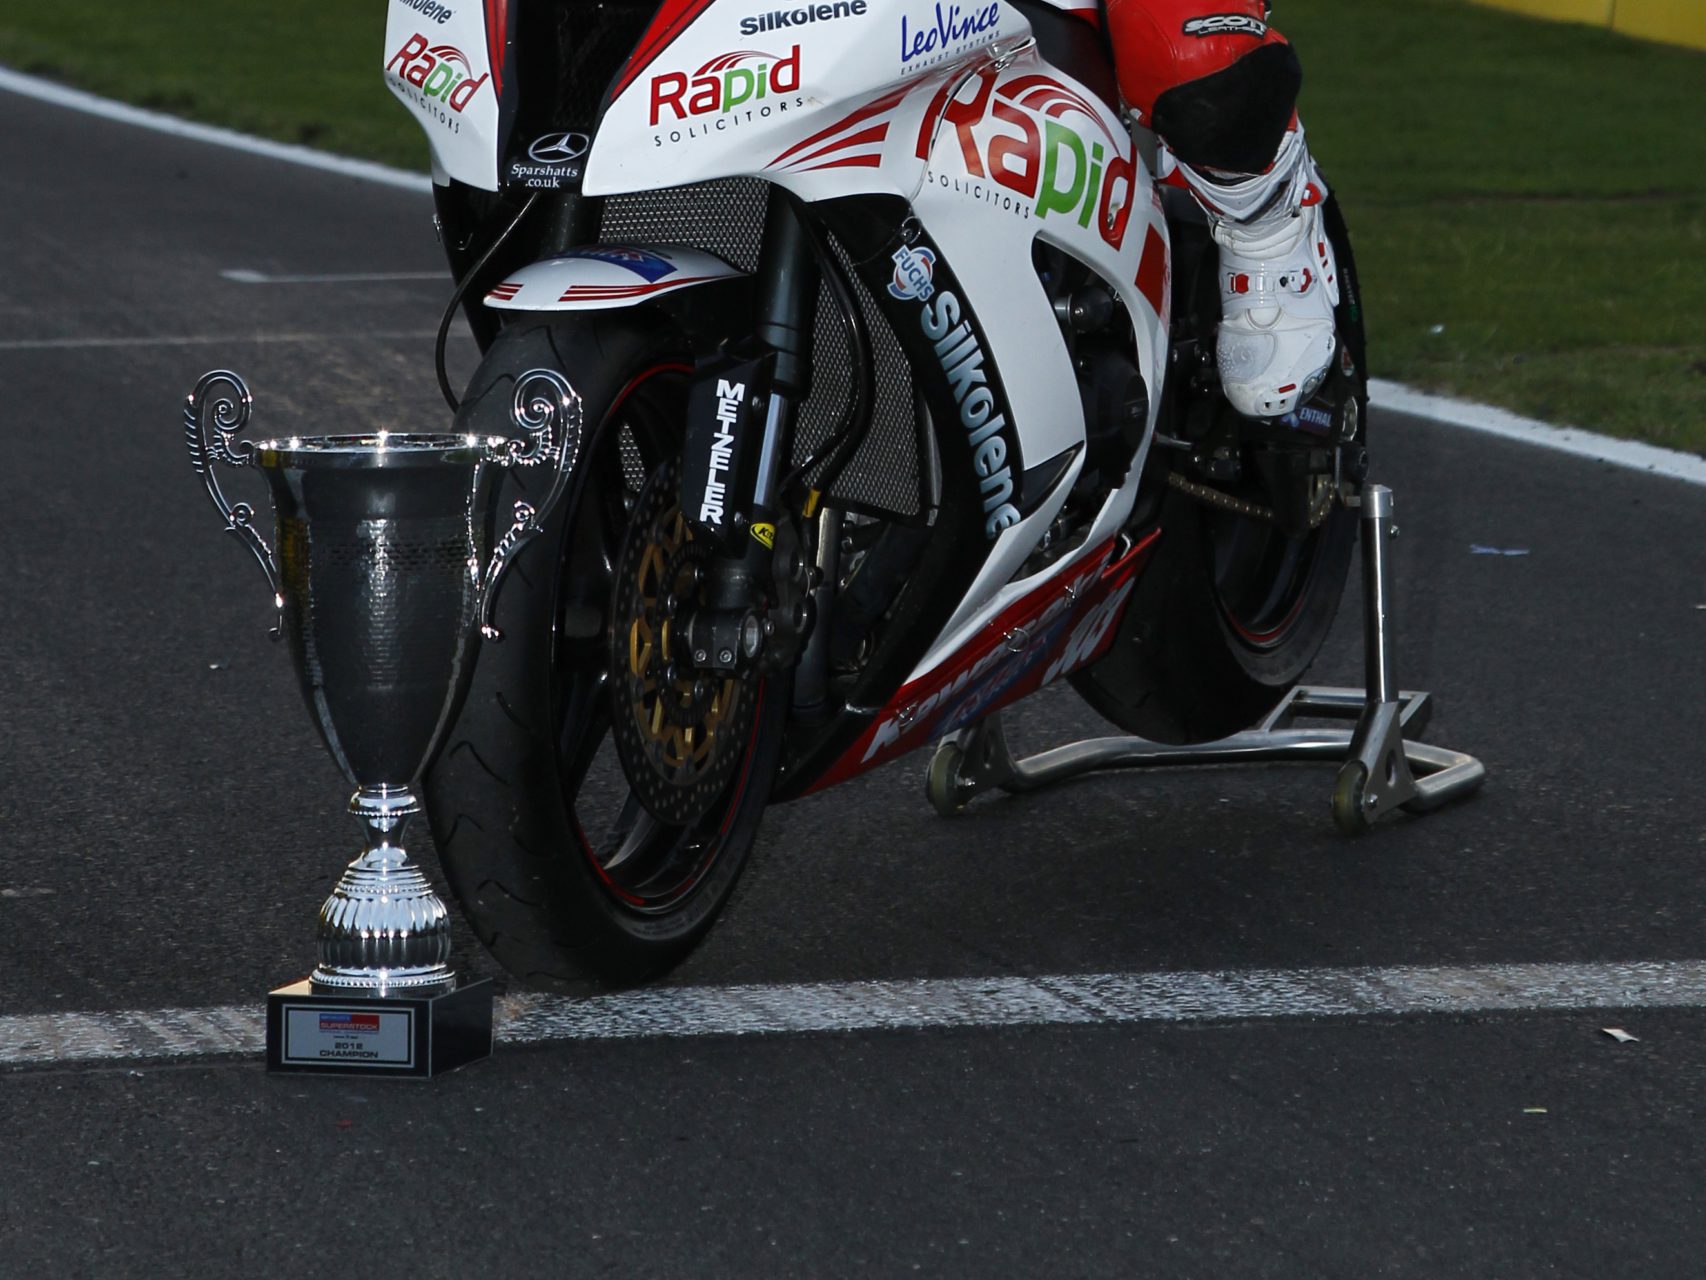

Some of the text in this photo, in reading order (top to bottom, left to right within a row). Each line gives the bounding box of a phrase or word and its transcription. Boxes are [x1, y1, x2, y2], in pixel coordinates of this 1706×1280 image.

[902, 1, 1000, 62] LeoVince
[386, 33, 490, 113] Rapid
[650, 44, 801, 127] Rapid
[901, 51, 949, 75] EXHAUST
[389, 77, 460, 134] SOLICITORS
[654, 97, 804, 147] SOLICITORS
[511, 164, 579, 178] Sparshatts
[915, 67, 1138, 252] Rapid
[928, 171, 1030, 220] SOLICITORS
[894, 246, 934, 301] FUCHS
[921, 291, 1022, 539] Silkolene
[1297, 407, 1332, 427] ENTHAL
[700, 378, 746, 525] METZELER
[319, 1050, 378, 1058] CHAMPION
